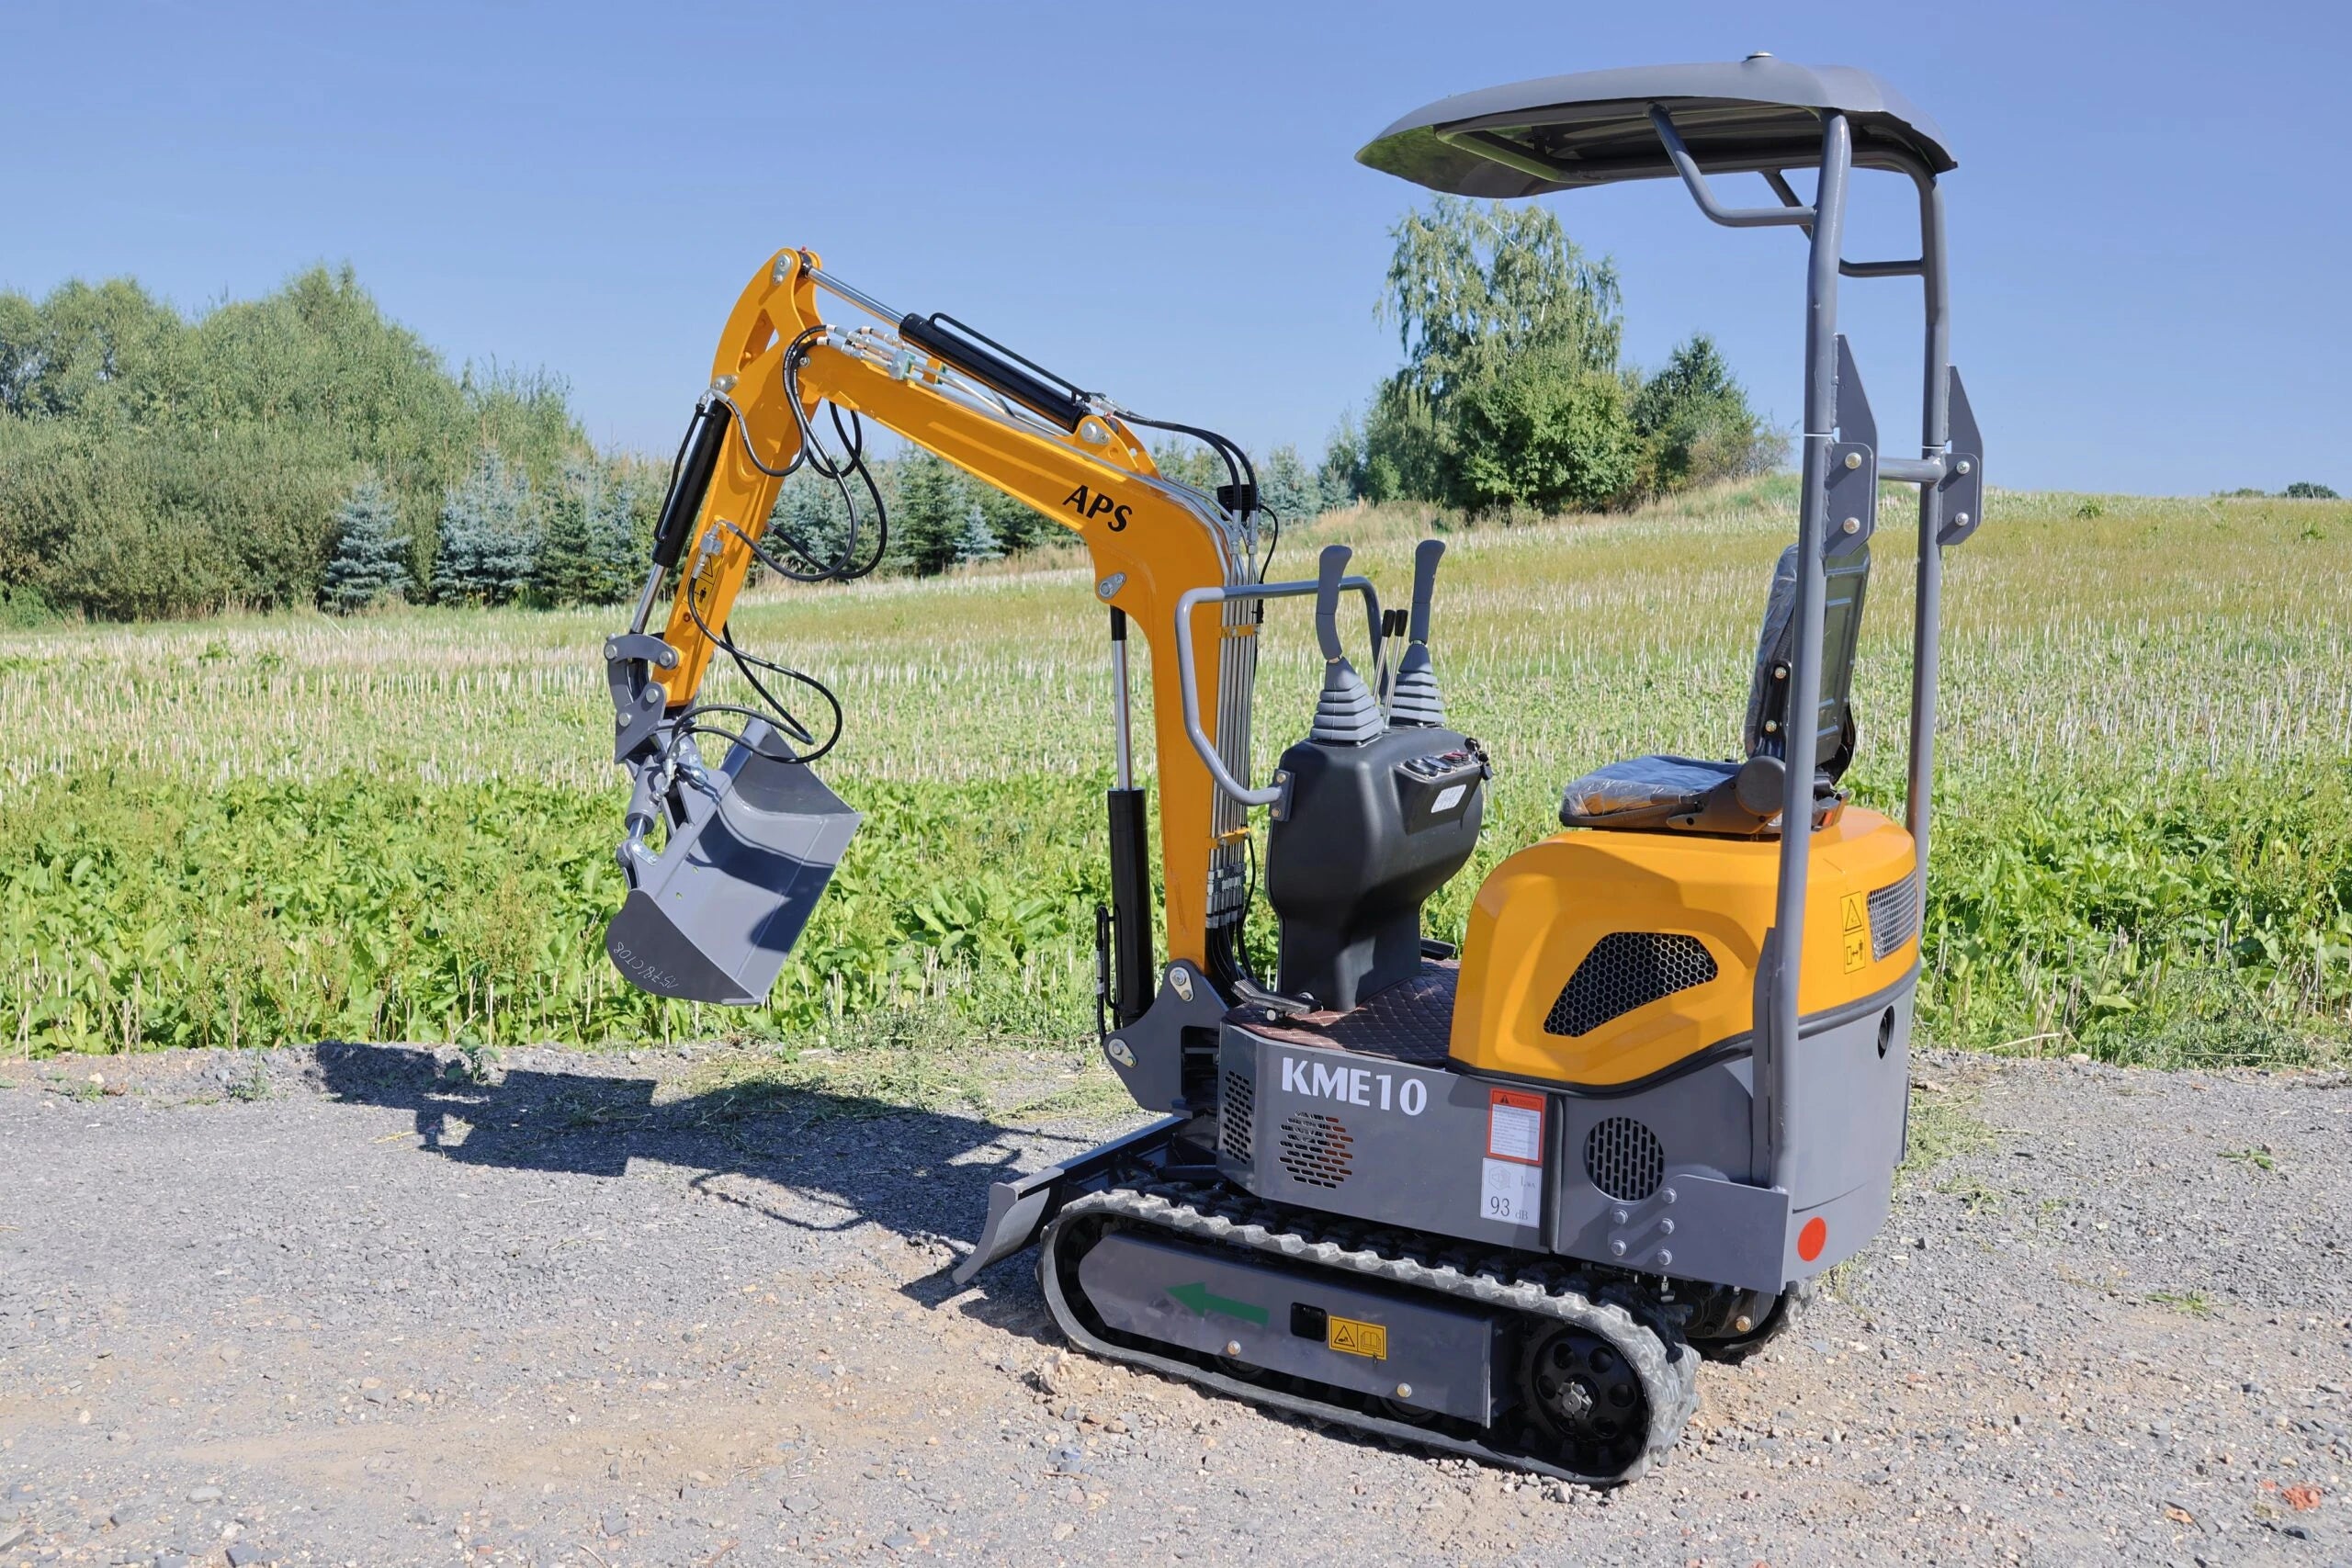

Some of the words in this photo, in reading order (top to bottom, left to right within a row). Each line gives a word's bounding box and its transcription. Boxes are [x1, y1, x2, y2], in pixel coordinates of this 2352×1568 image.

[1062, 484, 1133, 532] APS
[1282, 1057, 1428, 1116] KME10
[1490, 1196, 1510, 1217] 93
[1515, 1209, 1529, 1221] dB
